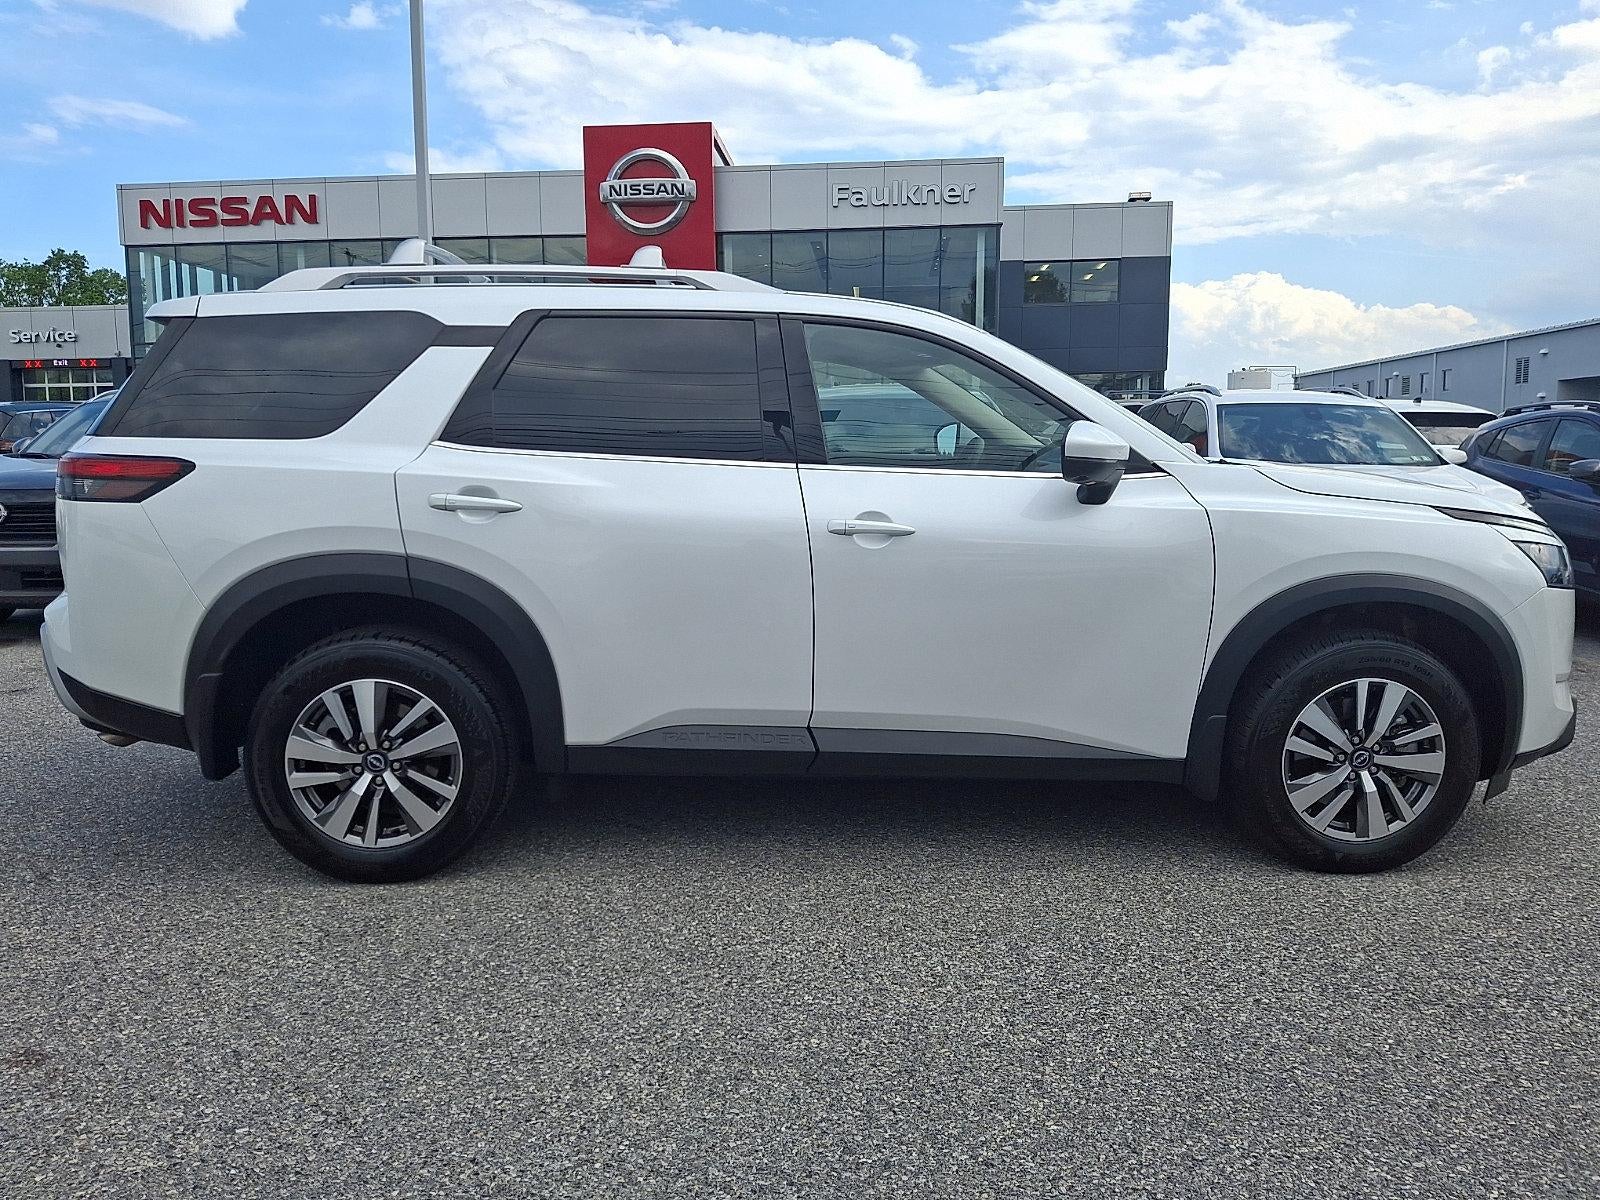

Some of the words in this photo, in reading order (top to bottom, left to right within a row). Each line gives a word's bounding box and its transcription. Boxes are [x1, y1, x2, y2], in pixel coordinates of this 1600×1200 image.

[608, 183, 686, 198] NISSAN
[832, 180, 976, 207] Faulkner
[139, 194, 319, 229] NISSAN
[8, 326, 77, 344] Service
[662, 732, 810, 745] PATHFINDER
